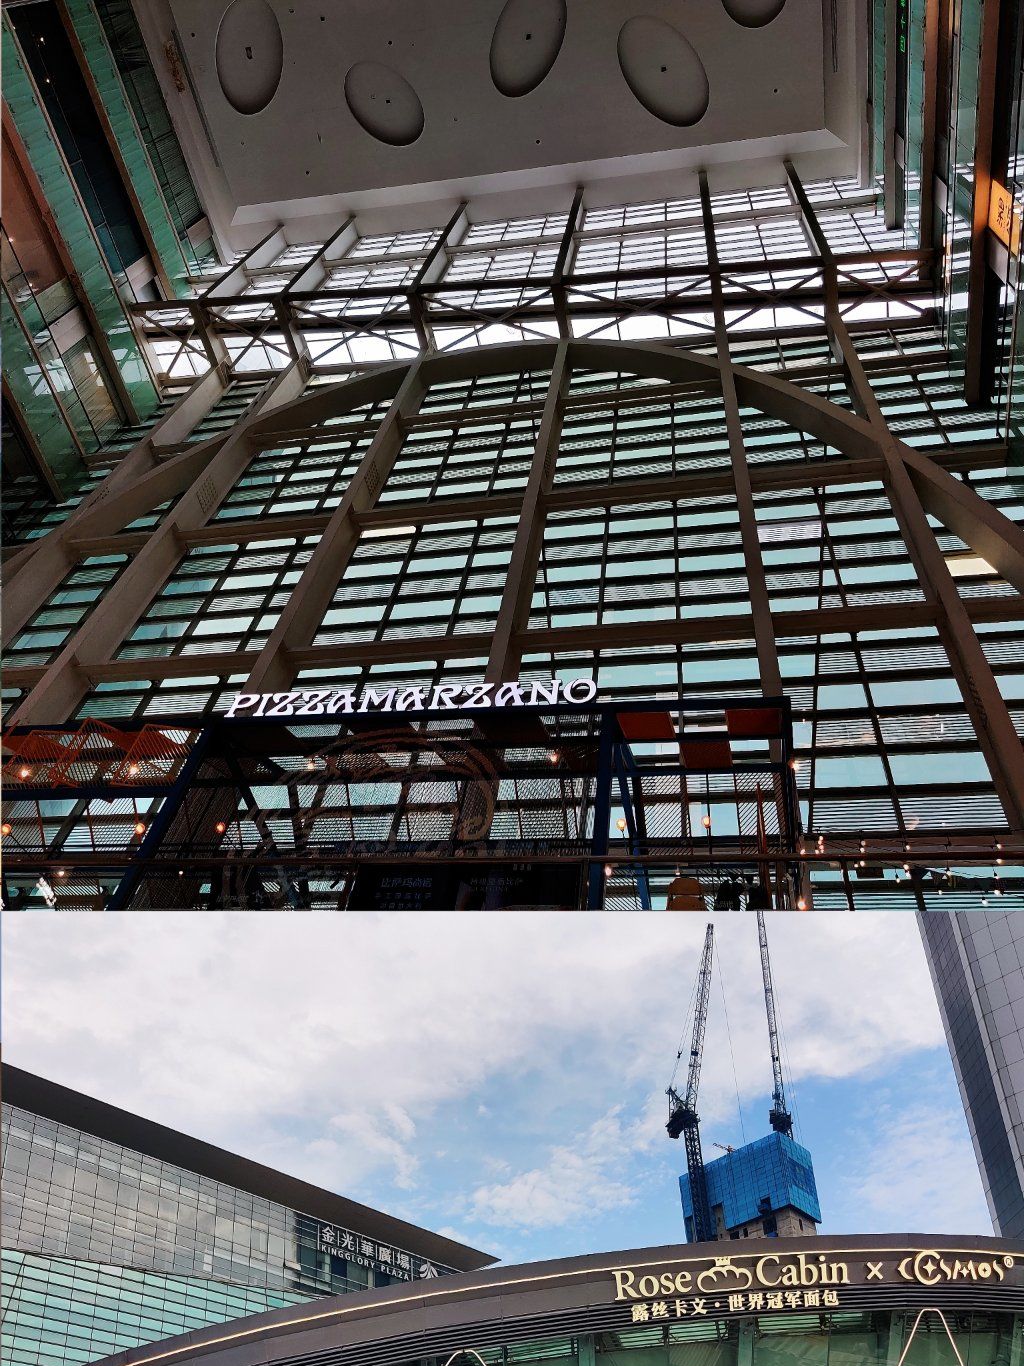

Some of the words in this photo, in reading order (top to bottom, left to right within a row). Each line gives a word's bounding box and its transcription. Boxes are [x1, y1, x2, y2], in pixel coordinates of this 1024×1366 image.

[380, 1265, 410, 1281] PLAZA
[612, 1270, 693, 1301] Rose
[756, 1254, 851, 1286] Cabin
